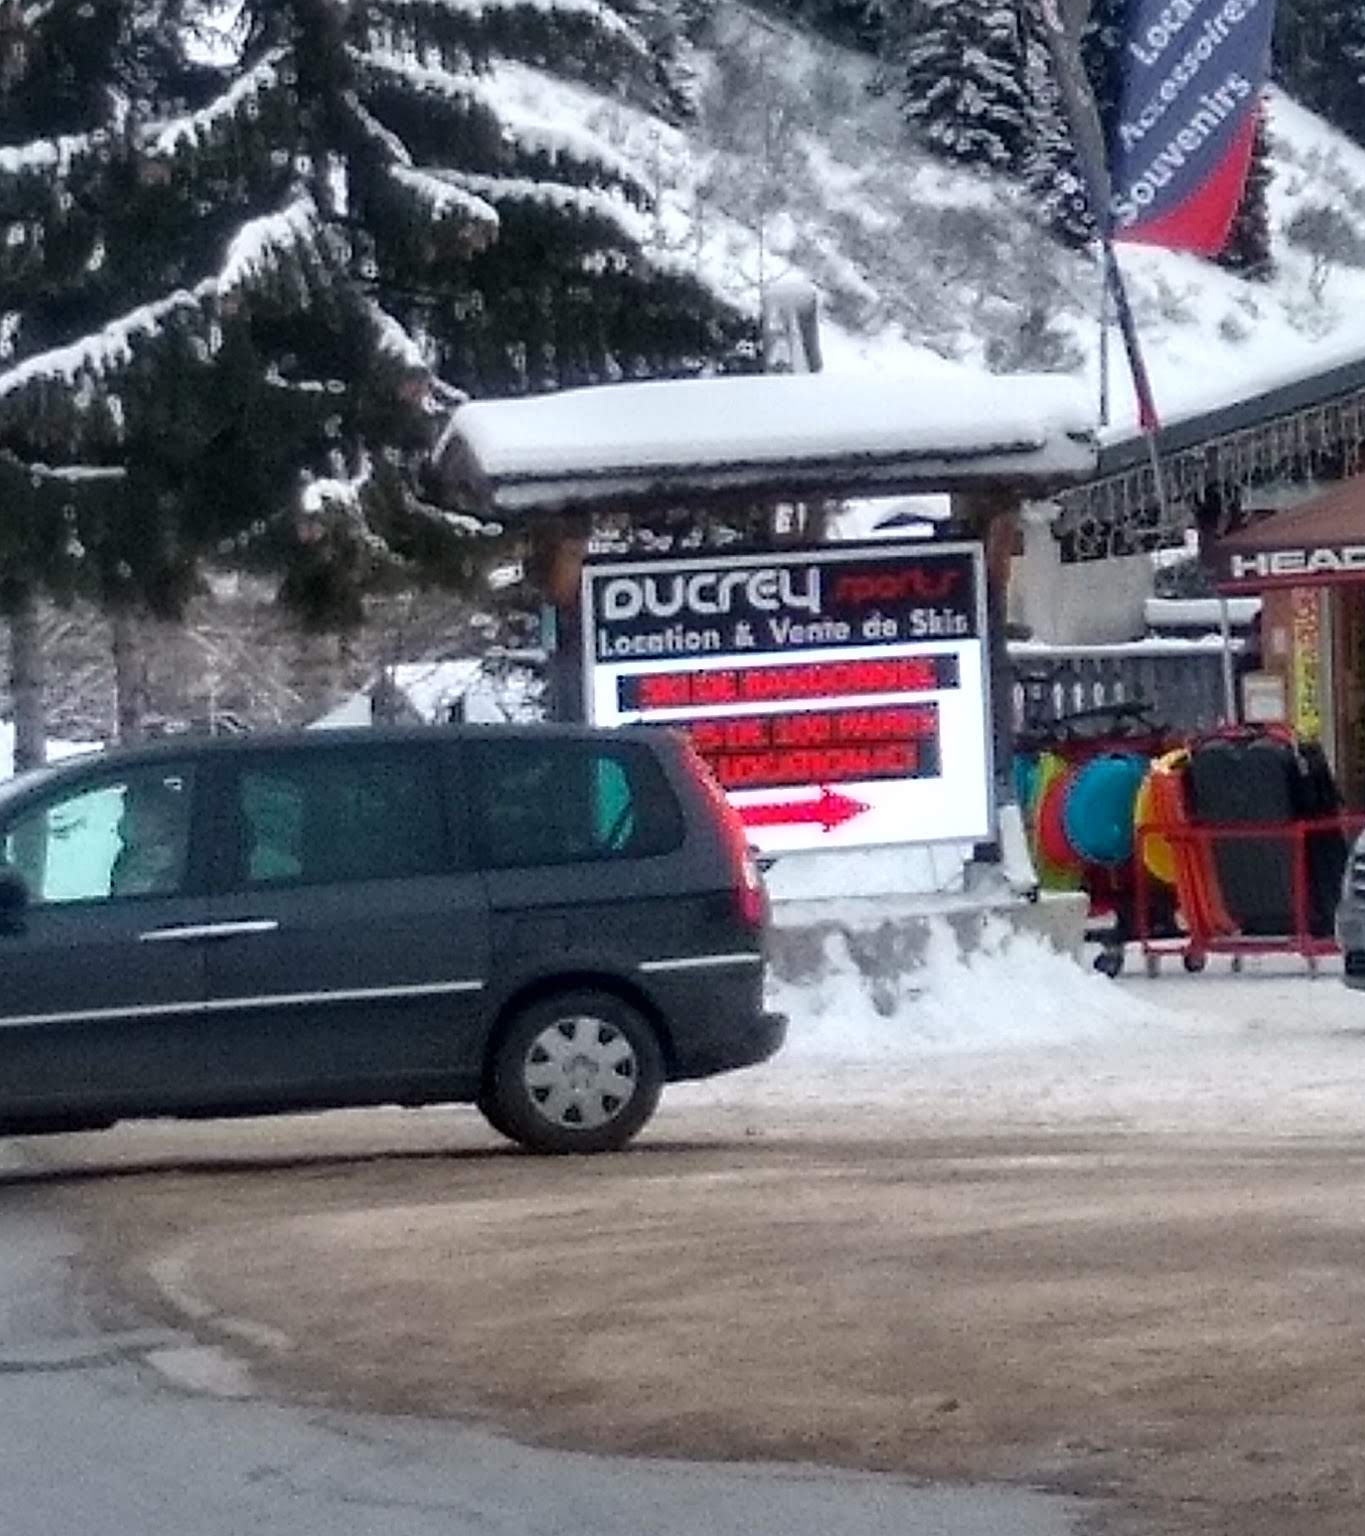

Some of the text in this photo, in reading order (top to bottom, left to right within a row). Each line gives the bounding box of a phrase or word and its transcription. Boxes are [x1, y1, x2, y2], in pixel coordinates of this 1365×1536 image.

[1111, 70, 1253, 226] Souvenirs
[600, 622, 721, 657] Location
[769, 615, 851, 646] Vente
[862, 610, 898, 639] de
